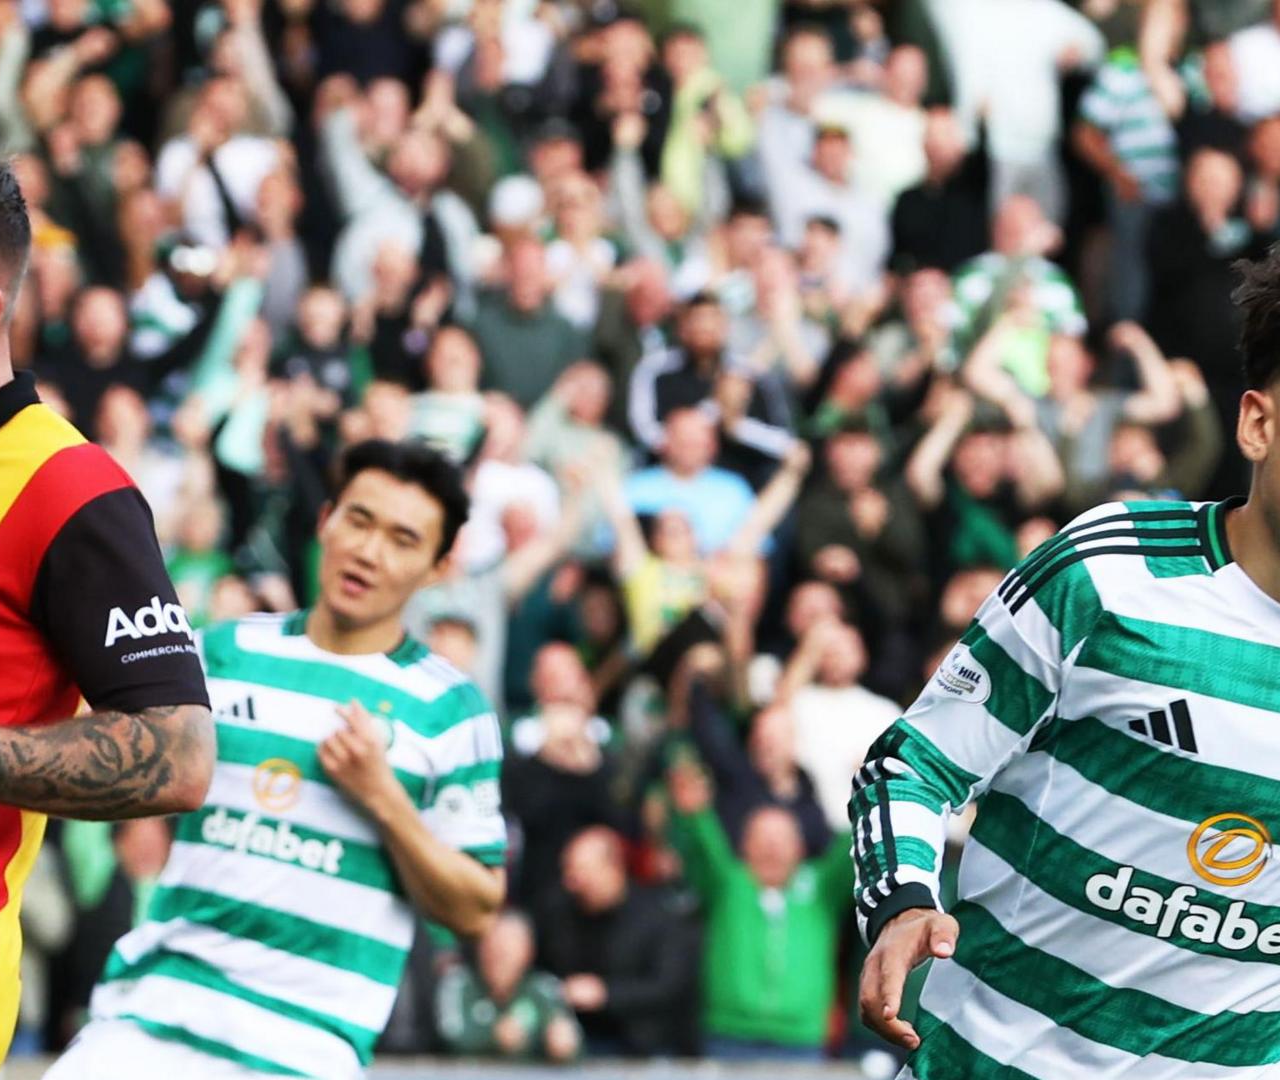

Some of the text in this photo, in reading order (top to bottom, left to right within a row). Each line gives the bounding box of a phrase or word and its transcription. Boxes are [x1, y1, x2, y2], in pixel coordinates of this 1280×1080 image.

[120, 645, 185, 664] COMMERCIAL
[959, 666, 981, 684] HILL
[201, 807, 345, 874] dafabet
